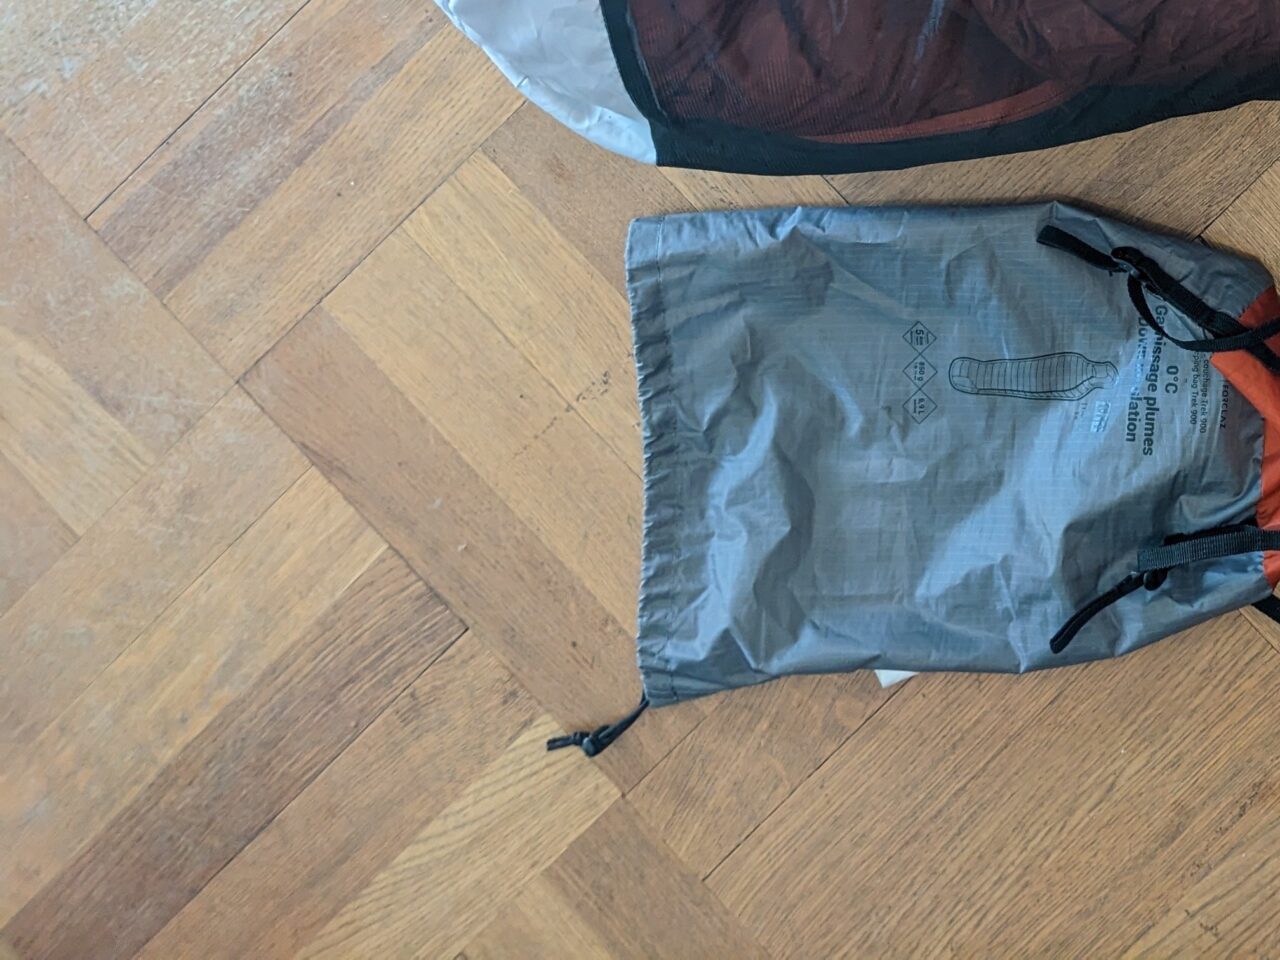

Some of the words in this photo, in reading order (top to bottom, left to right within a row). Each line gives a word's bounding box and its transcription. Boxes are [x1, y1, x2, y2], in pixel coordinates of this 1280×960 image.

[1165, 365, 1179, 394] 0°C
[1190, 374, 1199, 389] bag
[1190, 391, 1199, 407] Trek
[1220, 384, 1229, 430] FORCLAZ
[1189, 408, 1198, 425] 900
[1200, 400, 1209, 416] Trek
[1143, 396, 1159, 456] plumes
[1199, 416, 1208, 434] 900
